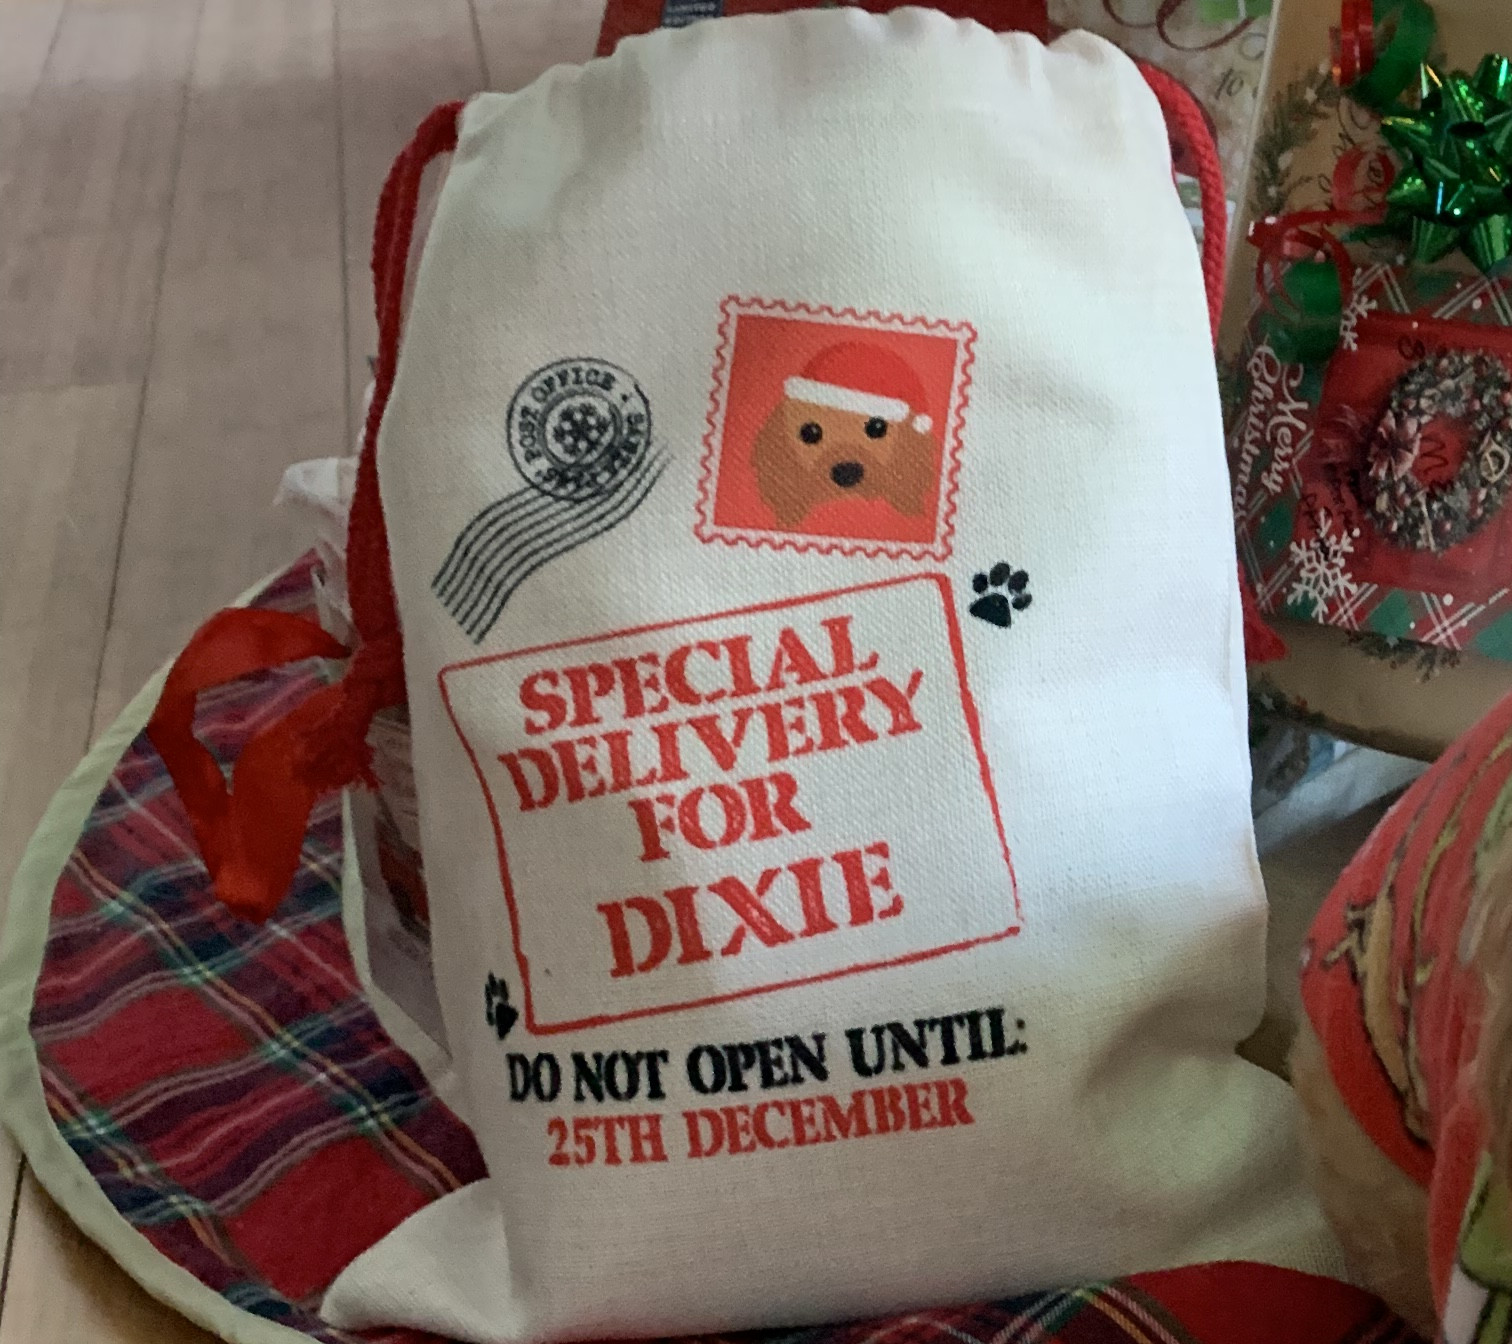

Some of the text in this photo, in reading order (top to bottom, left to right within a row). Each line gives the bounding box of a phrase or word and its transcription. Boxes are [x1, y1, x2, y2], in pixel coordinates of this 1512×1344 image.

[1261, 363, 1312, 496] Merry
[519, 613, 880, 737] SPECIAL
[499, 668, 924, 814] DELIVERY
[629, 771, 812, 863] FOR
[597, 841, 906, 981] DIXIE
[506, 1008, 1028, 1102] DO NOT OPEN UNTIL:
[548, 1079, 974, 1166] 25TH DECEMBER
